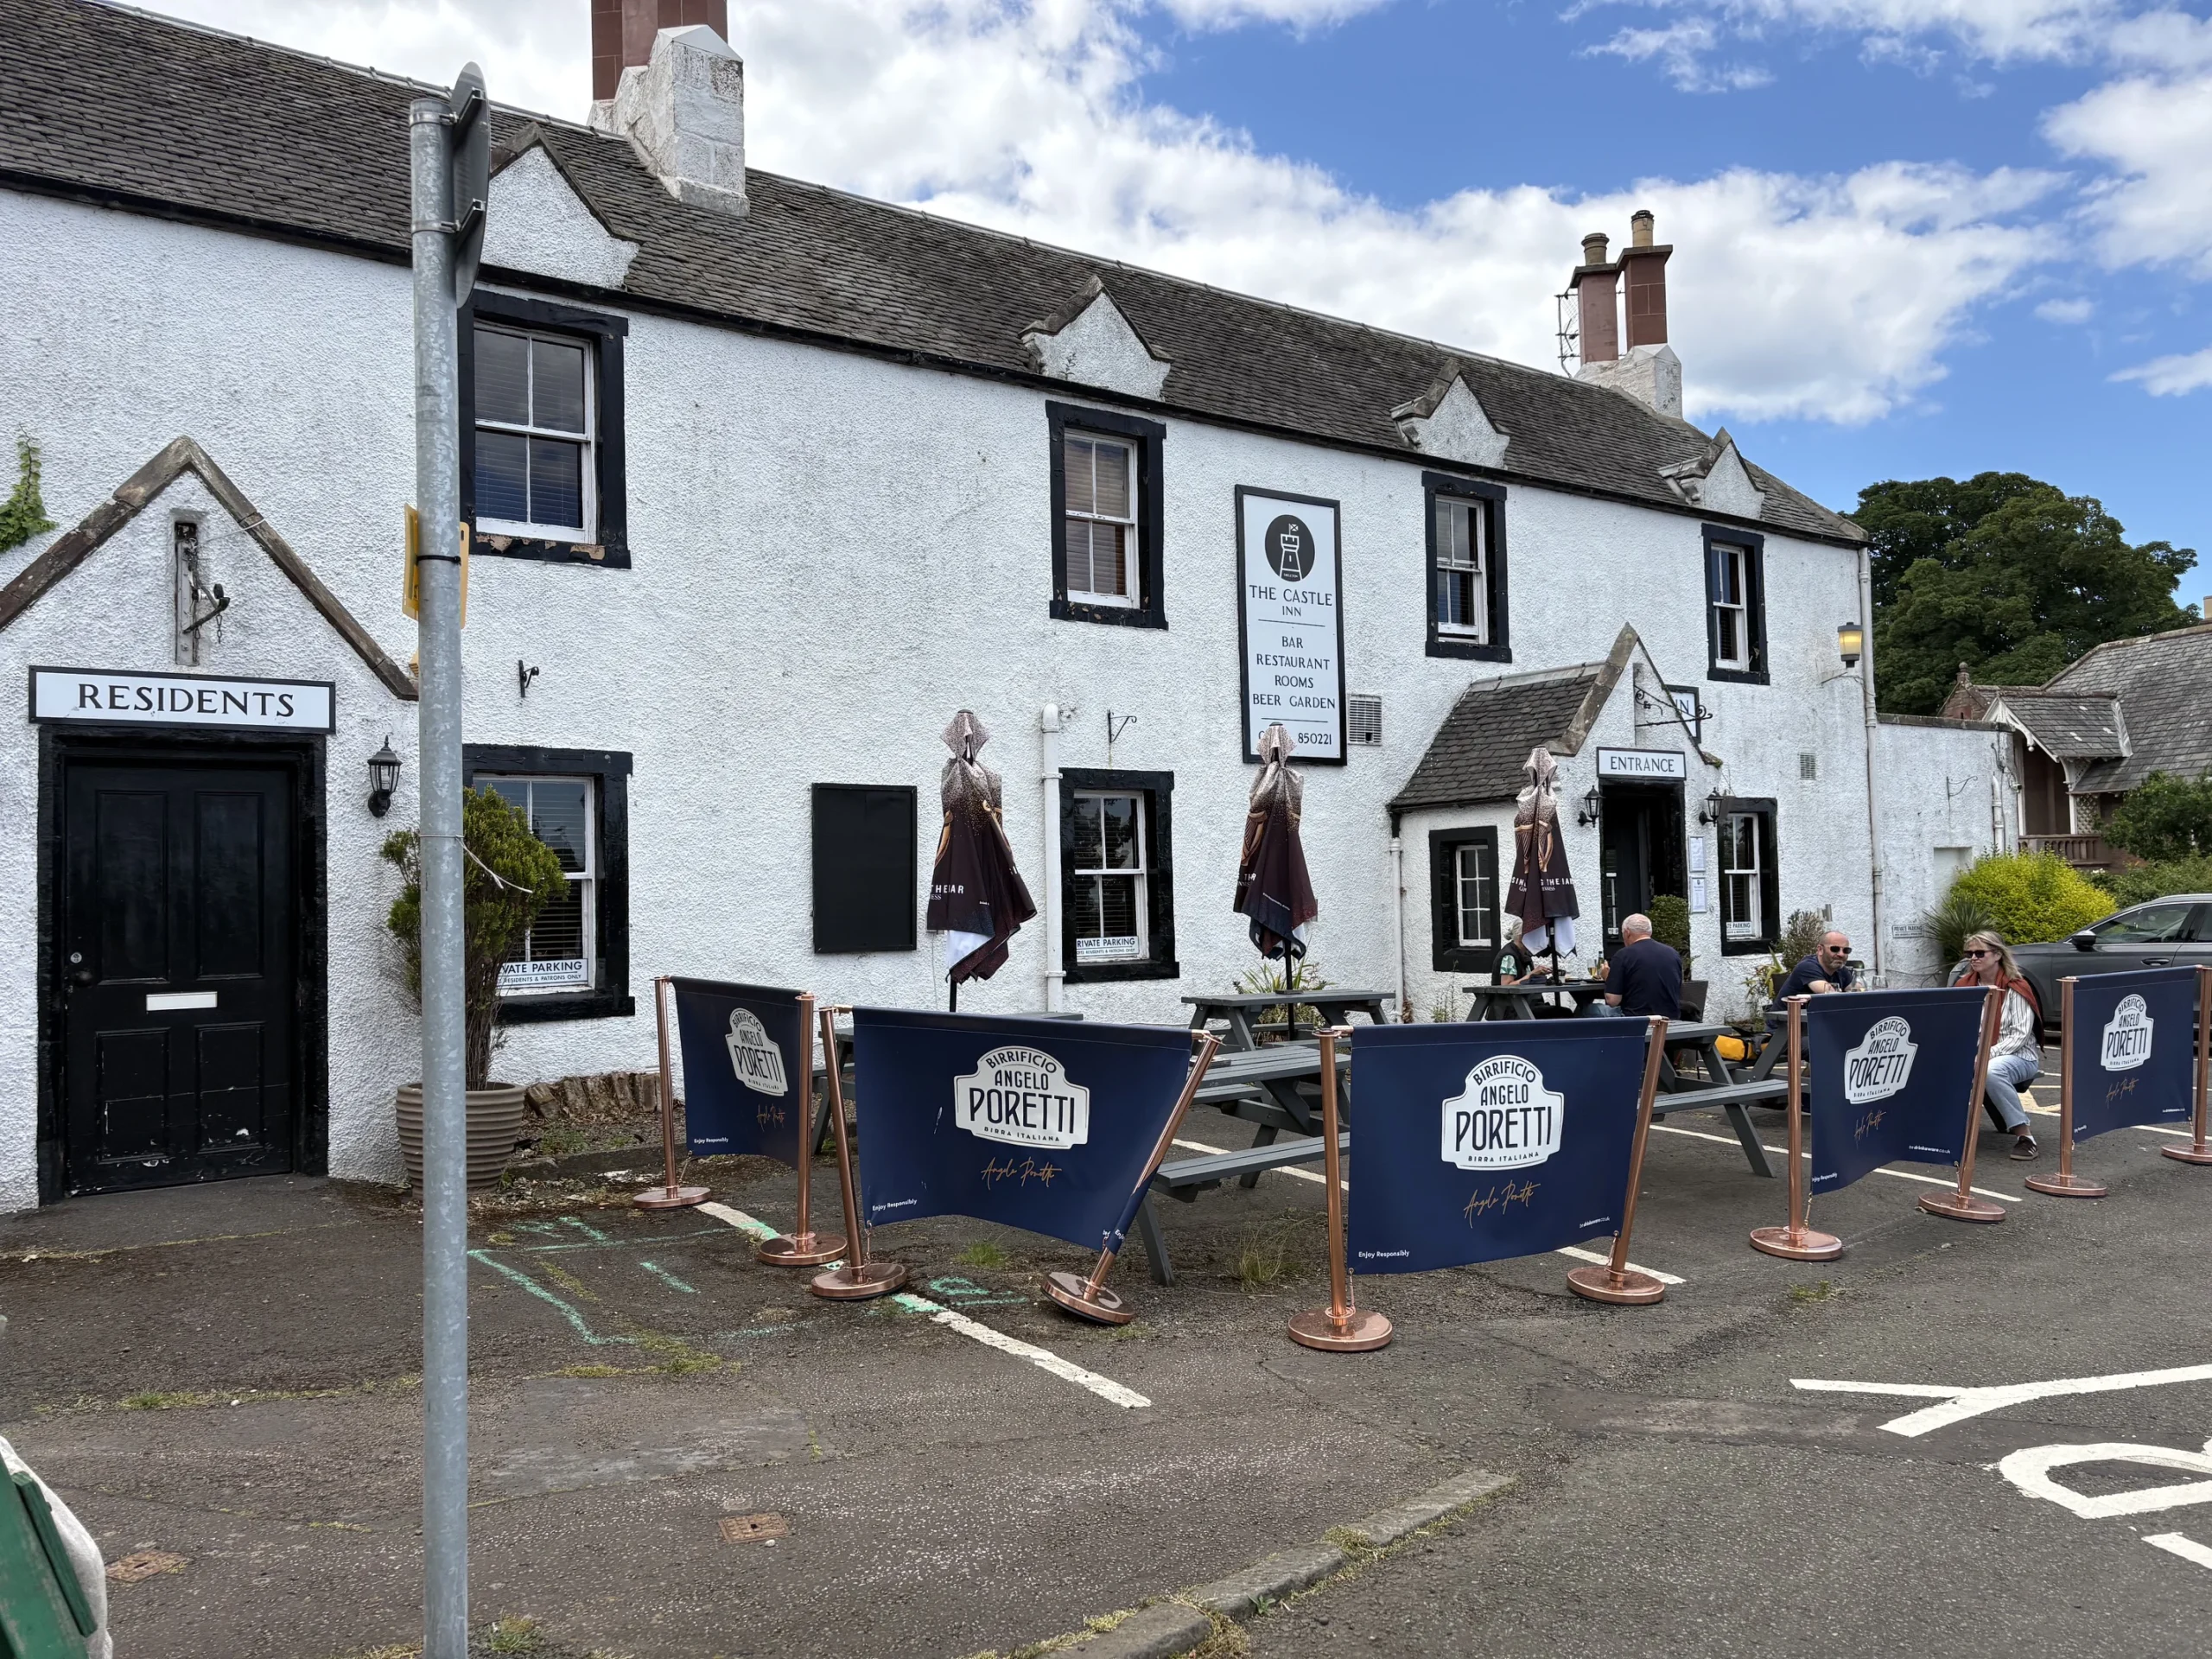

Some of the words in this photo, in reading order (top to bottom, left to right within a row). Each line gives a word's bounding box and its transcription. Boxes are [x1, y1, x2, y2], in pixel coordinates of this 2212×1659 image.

[1249, 584, 1277, 601] THE
[1283, 588, 1332, 607] CASTLE
[1282, 606, 1301, 617] INN
[1281, 636, 1303, 649] BAR
[1256, 653, 1330, 670] RESTAURANT
[1274, 675, 1313, 689] ROOMS
[78, 683, 295, 717] RESIDENTS
[1253, 693, 1281, 706] BEER
[1289, 696, 1335, 709] GARDEN
[1298, 732, 1332, 745] 850221
[1611, 756, 1675, 772] ENTRANCE
[1077, 939, 1100, 948] RIVATE
[1103, 938, 1135, 946] PARKING
[503, 963, 527, 974] VATE
[532, 961, 582, 972] PARKING
[2118, 998, 2145, 1014] BIRRIFICIO
[732, 1013, 762, 1032] BIRRIFICIO
[2119, 1013, 2139, 1028] ANGELO
[740, 1029, 764, 1047] ANGELO
[1869, 1020, 1907, 1039] BIRRIFICIO
[1868, 1038, 1899, 1055] ANGELO
[2107, 1027, 2147, 1058] PORETTI
[734, 1045, 782, 1083] PORETTI
[985, 1051, 1057, 1073] BIRRIFICIO
[995, 1070, 1049, 1090] ANGELO
[1472, 1060, 1536, 1085] BIRRIFICIO
[1849, 1054, 1908, 1090] PORETTI
[1480, 1084, 1529, 1106] ANGELO
[969, 1087, 1075, 1135] PORETTI
[984, 1126, 1012, 1136] BIRRA
[1017, 1132, 1059, 1141] ITALIANA
[1455, 1106, 1552, 1152] PORETTI
[1499, 1151, 1539, 1162] ITALIANA
[887, 1198, 917, 1208] Responsibly
[1376, 1249, 1409, 1258] Responsibly
